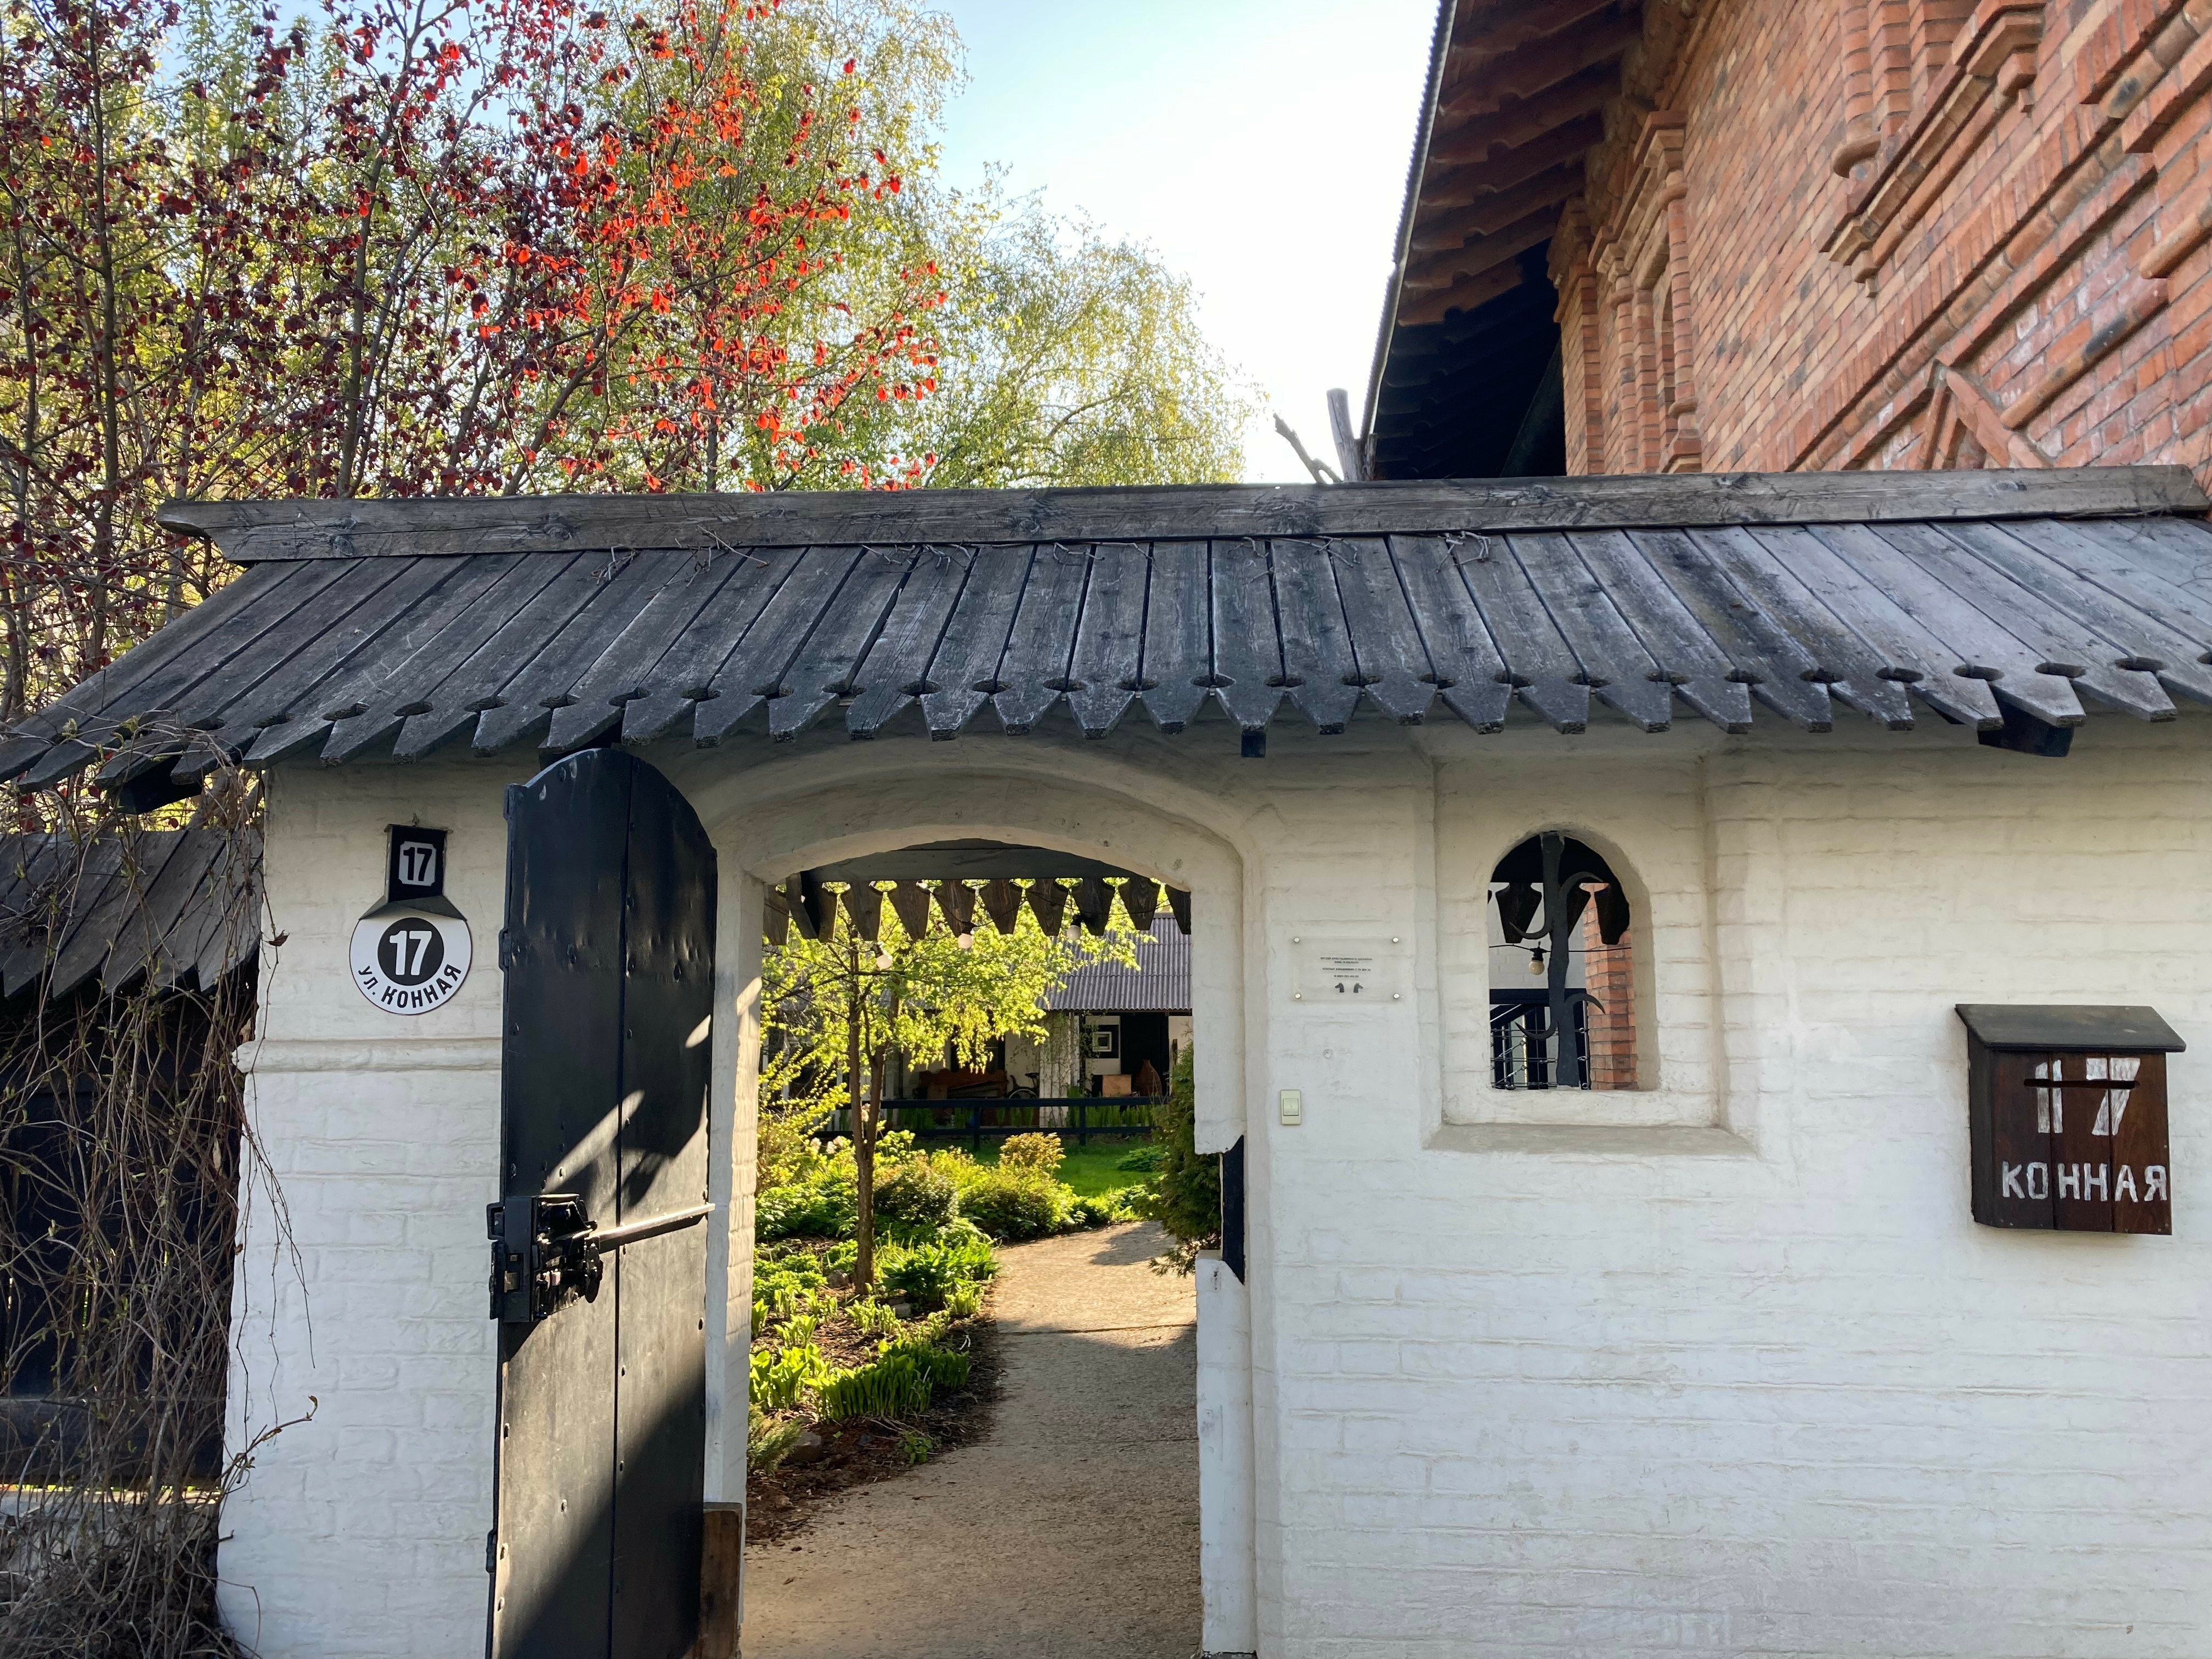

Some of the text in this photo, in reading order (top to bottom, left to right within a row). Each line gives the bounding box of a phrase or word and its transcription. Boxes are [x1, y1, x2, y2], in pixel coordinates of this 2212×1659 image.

[403, 847, 432, 882] 17
[389, 930, 432, 976] 17
[381, 963, 462, 1008] КОННАЯ
[2035, 1057, 2141, 1136] 17
[2002, 1161, 2168, 1203] КОННАЯ
